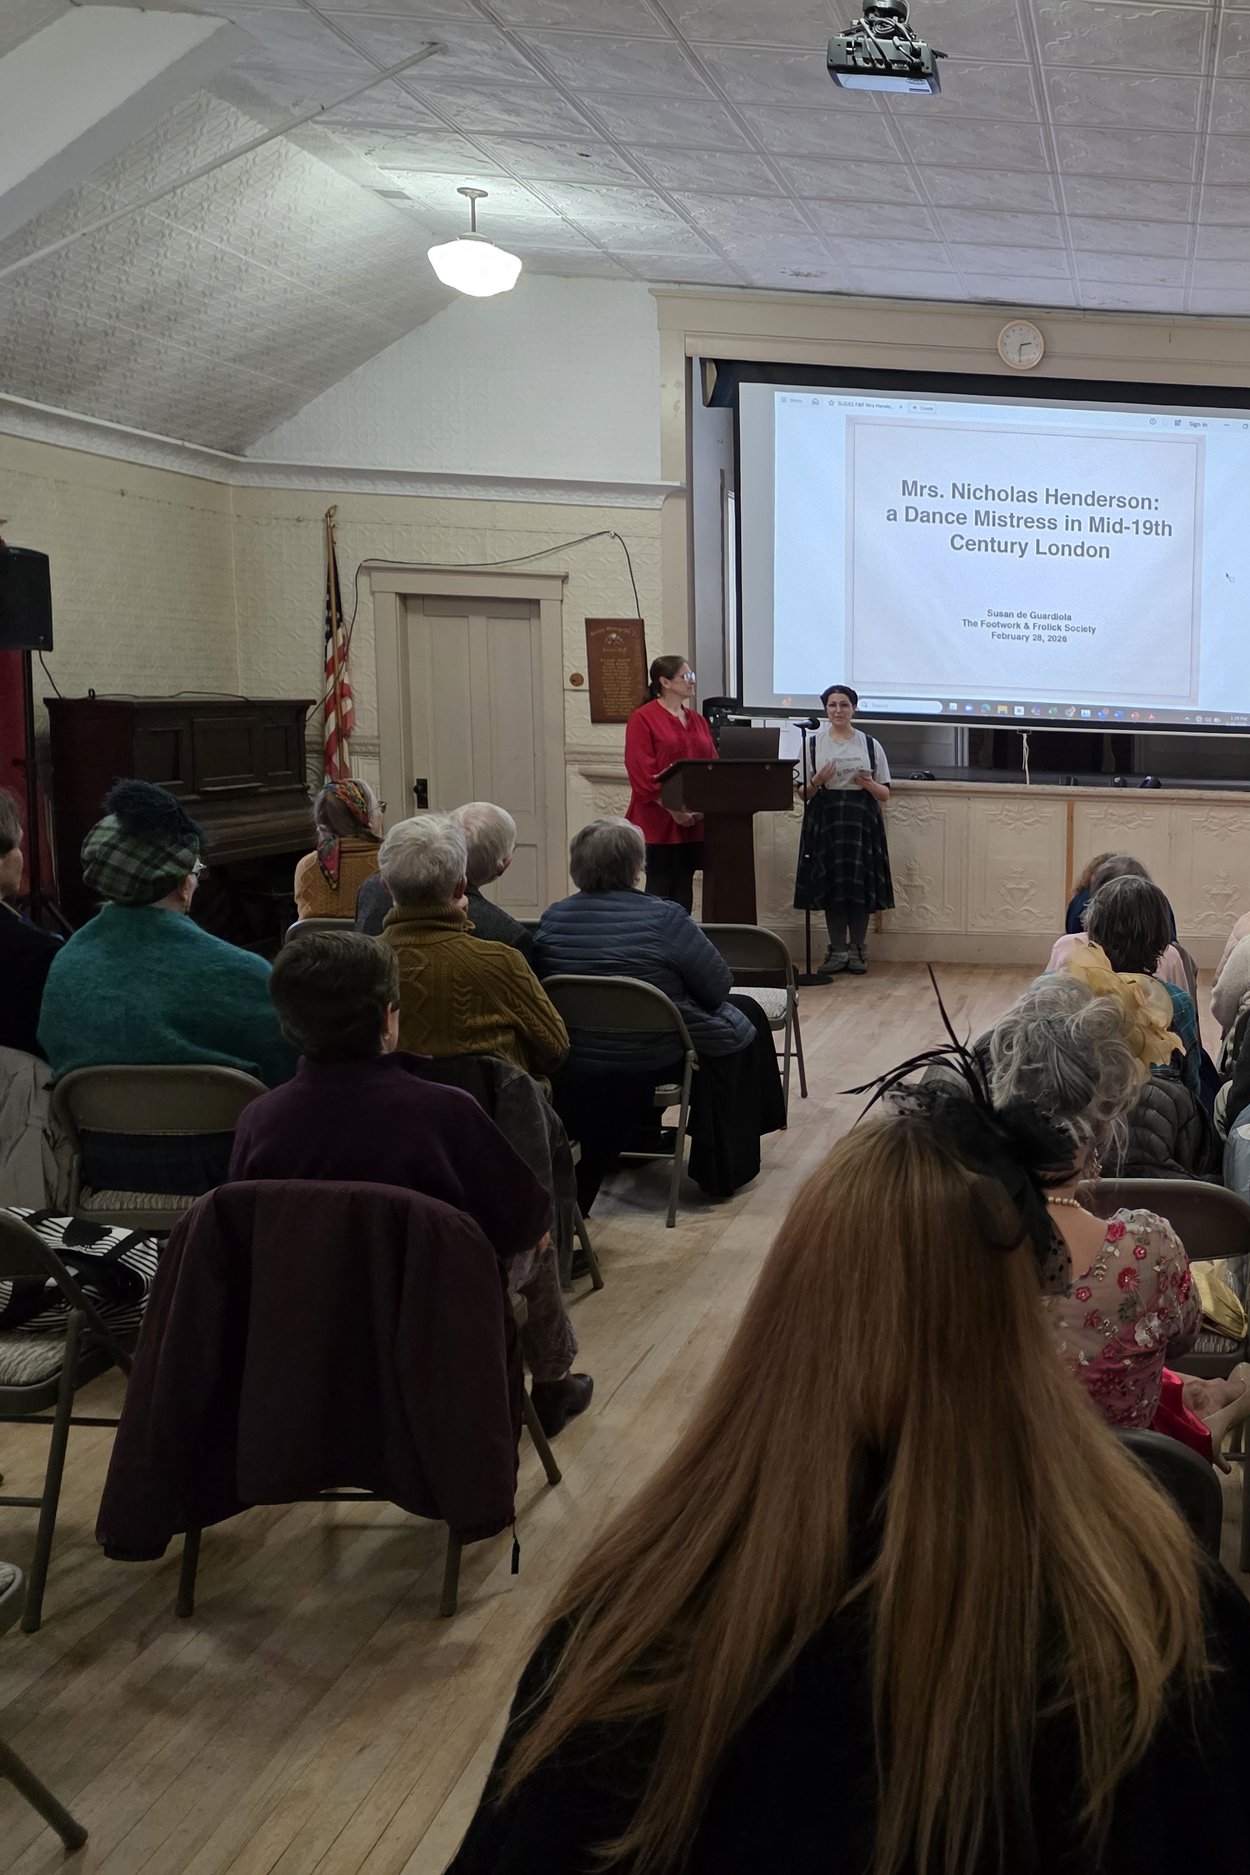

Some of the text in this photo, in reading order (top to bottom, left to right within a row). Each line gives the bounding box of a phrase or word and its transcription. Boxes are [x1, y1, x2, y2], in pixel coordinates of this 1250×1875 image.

[1189, 421, 1201, 429] Sign
[901, 479, 1159, 511] Mrs. Nicholas Henderson:
[886, 506, 1173, 537] a Dance Mistress in Mid-19th
[950, 534, 1110, 559] Century London
[987, 609, 1072, 621] Susan de Guardiola
[963, 619, 979, 627] The
[980, 620, 1021, 630] Footwork
[1032, 623, 1062, 632] Frolick
[1064, 625, 1096, 634] Society
[991, 632, 1068, 643] February 28, 2026
